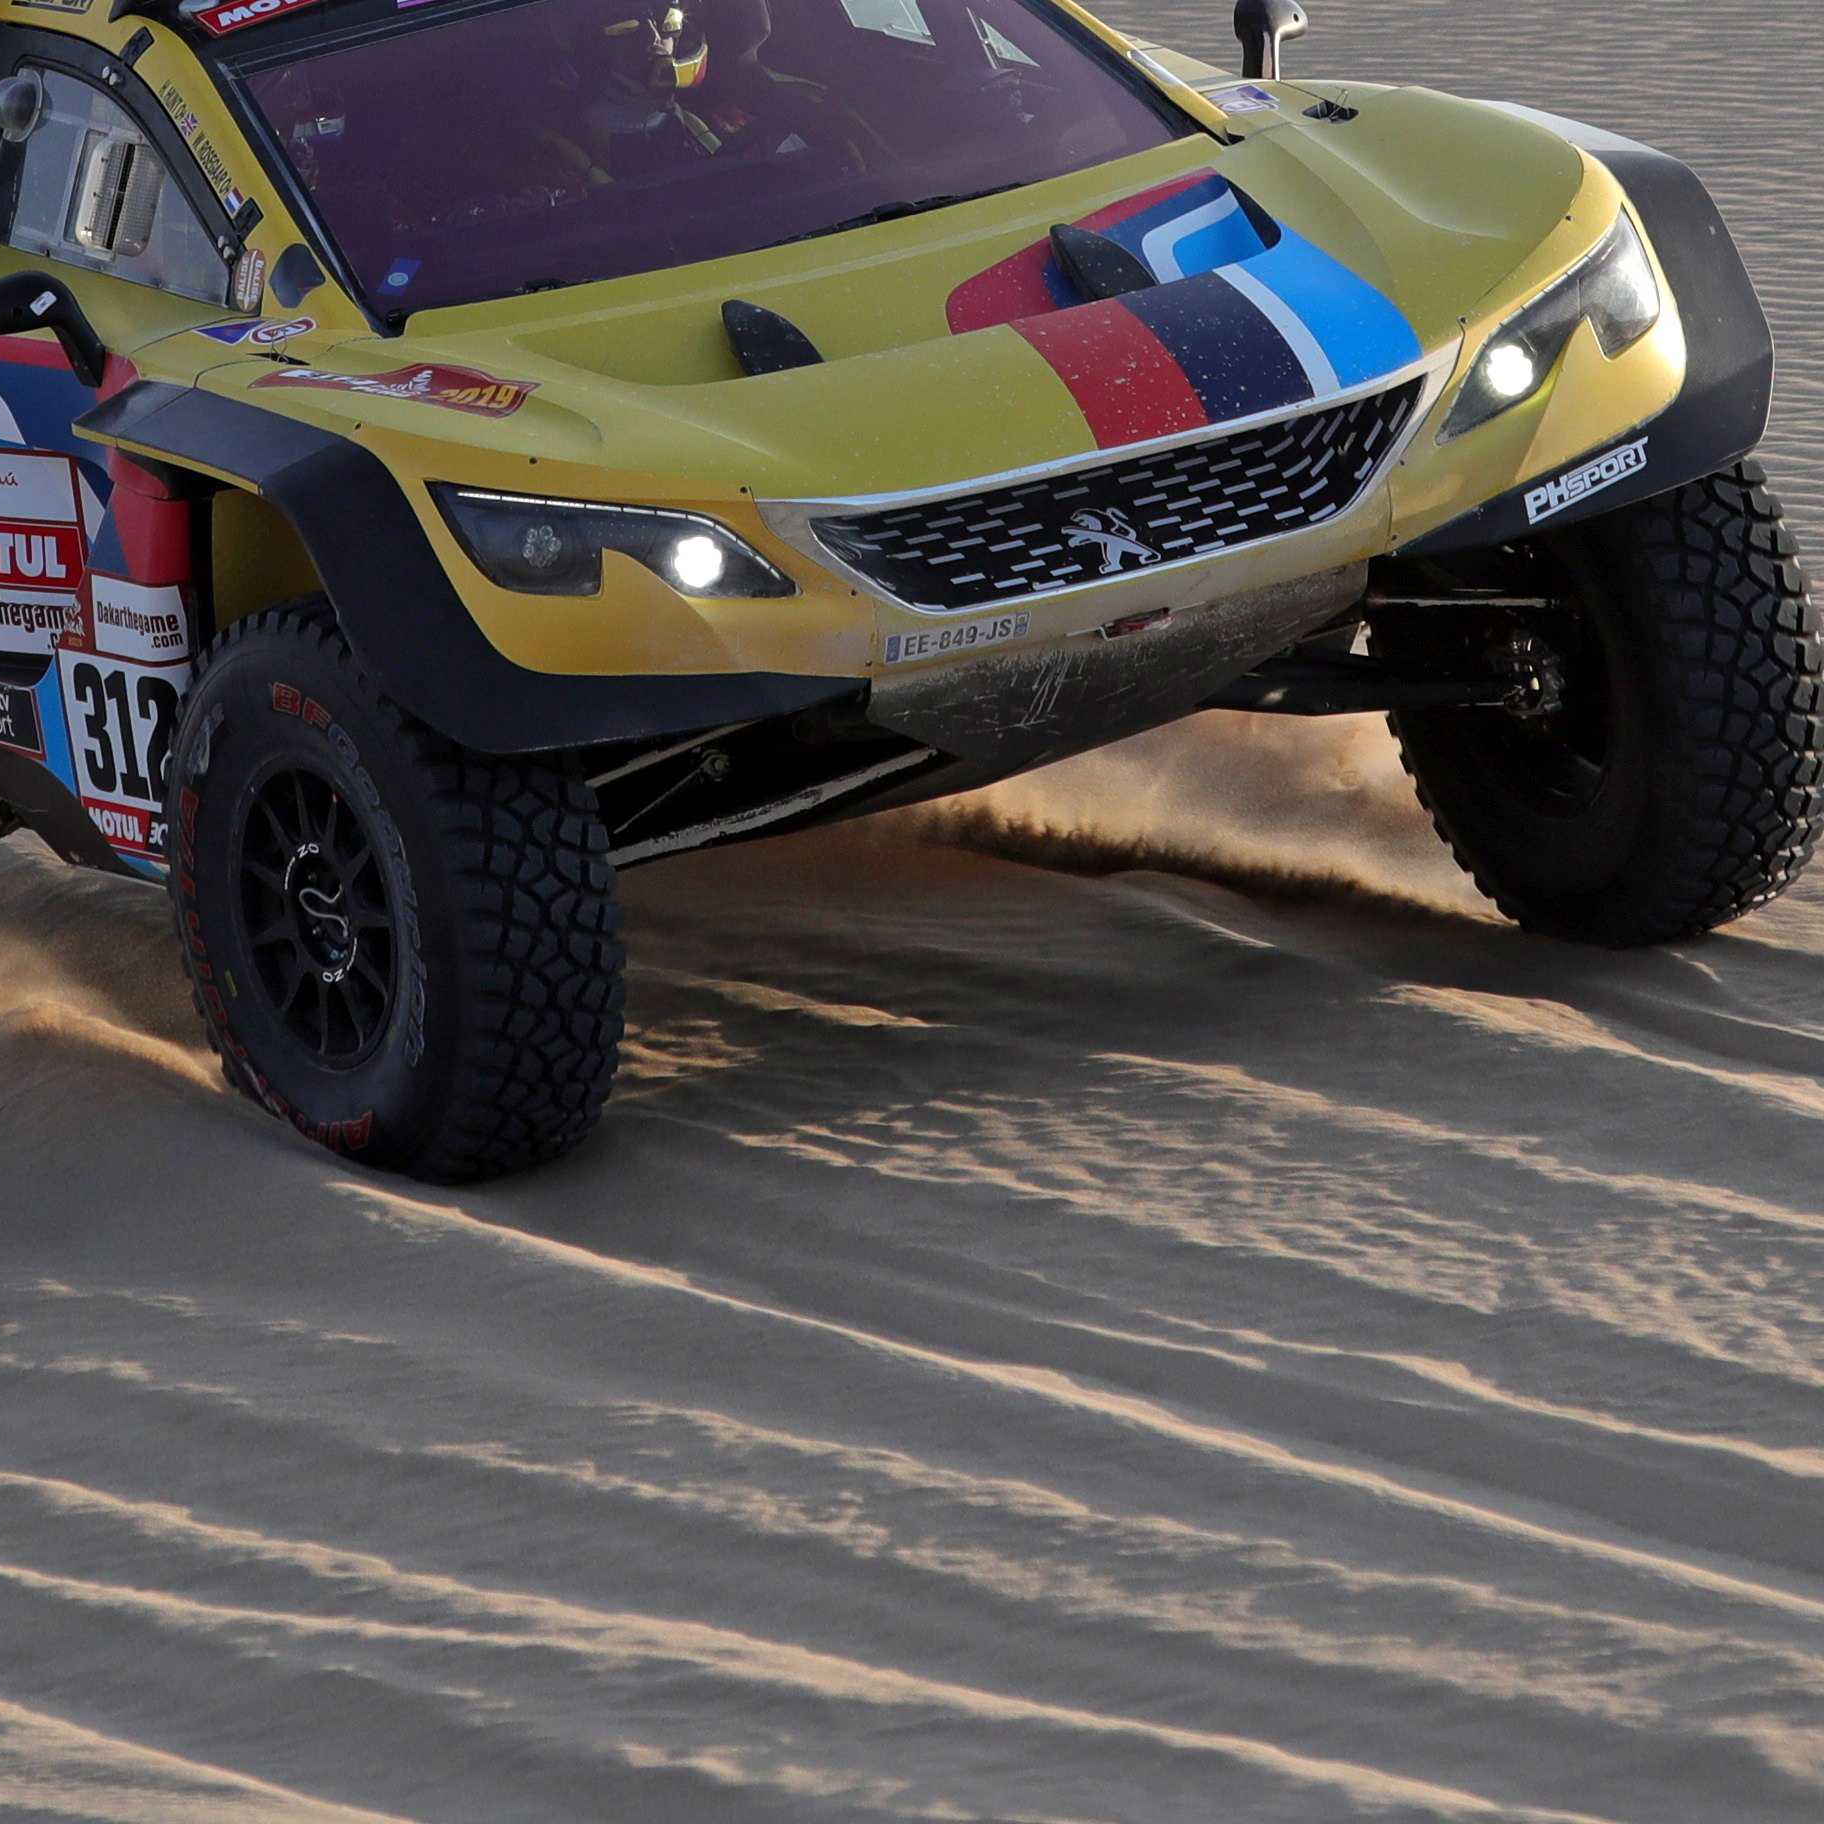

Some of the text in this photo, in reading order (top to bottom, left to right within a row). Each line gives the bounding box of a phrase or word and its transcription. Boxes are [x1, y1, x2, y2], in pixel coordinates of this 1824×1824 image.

[426, 385, 519, 409] 2019
[1524, 436, 1648, 523] PHSPORT
[96, 600, 178, 636] Dakarthegame
[150, 631, 184, 649] .com
[904, 619, 1012, 657] EE-849-JS
